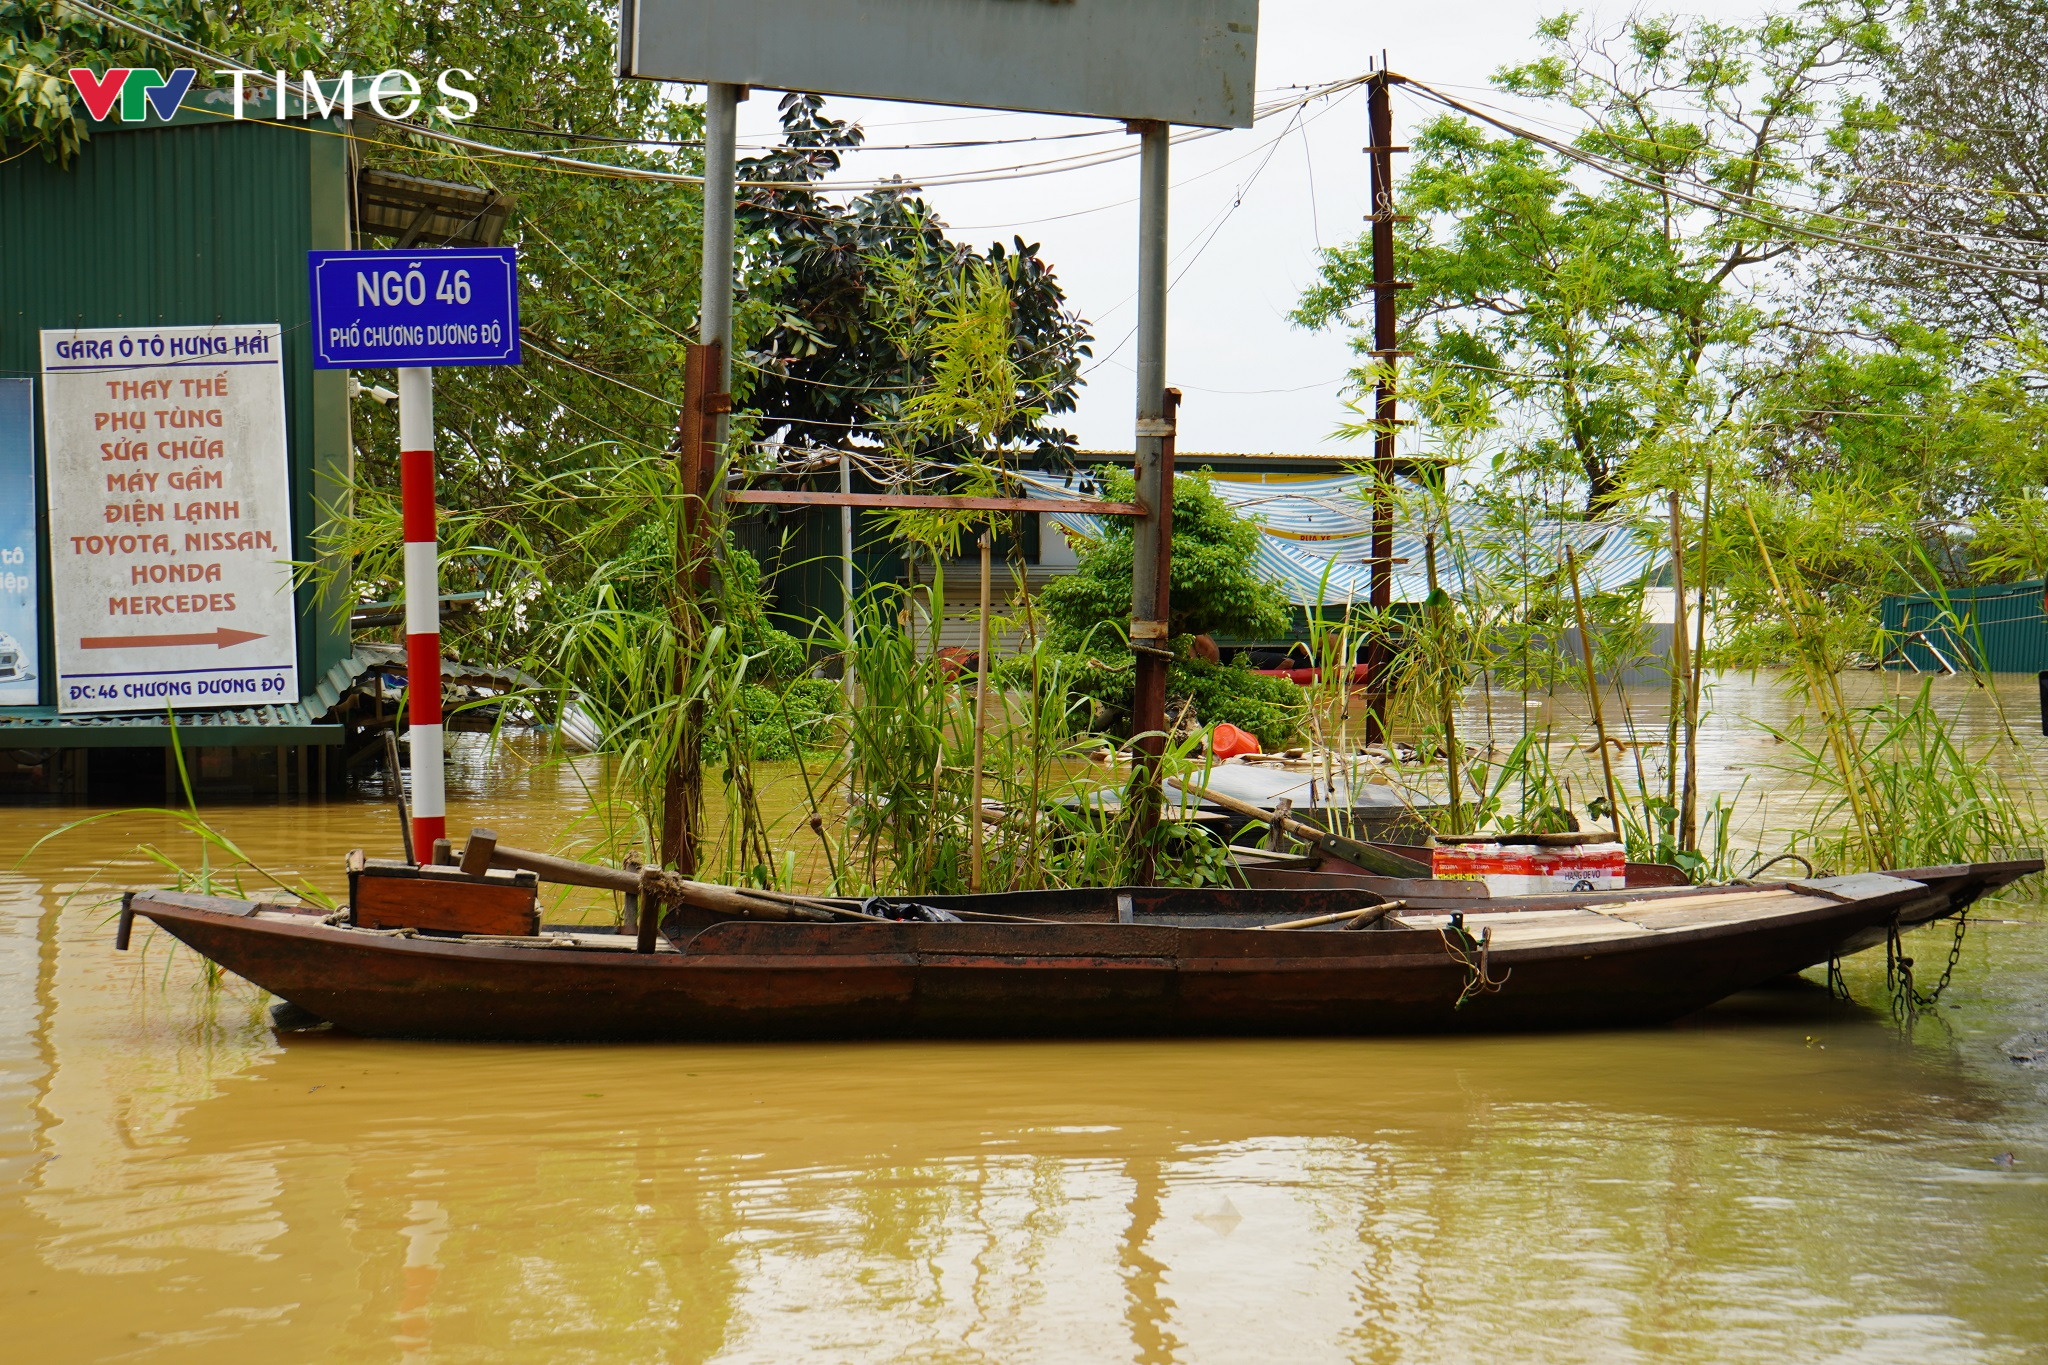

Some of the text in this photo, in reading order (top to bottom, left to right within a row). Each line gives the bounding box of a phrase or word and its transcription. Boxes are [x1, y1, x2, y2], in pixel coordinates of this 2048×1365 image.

[357, 262, 472, 307] NGÕ 46
[56, 330, 269, 360] GARA Ô TÔ HƯNG HẢI
[329, 319, 501, 348] PHỐ CHƯƠNG DƯƠNG ĐỘ
[106, 371, 228, 400] THAY THẾ
[95, 406, 223, 434] PHỤ TÙNG
[101, 436, 224, 461] SỬA CHỮA
[107, 465, 223, 493] MÁY GẦM
[105, 499, 240, 527] ĐIỆN LẠNH
[1, 546, 24, 564] tô
[71, 530, 278, 556] TOYOTA, NISSAN,
[131, 563, 222, 586] HONDA
[109, 593, 236, 615] MERCEDES
[70, 673, 285, 701] ĐC: 46 CHƯƠNG DƯƠNG ĐỘ
